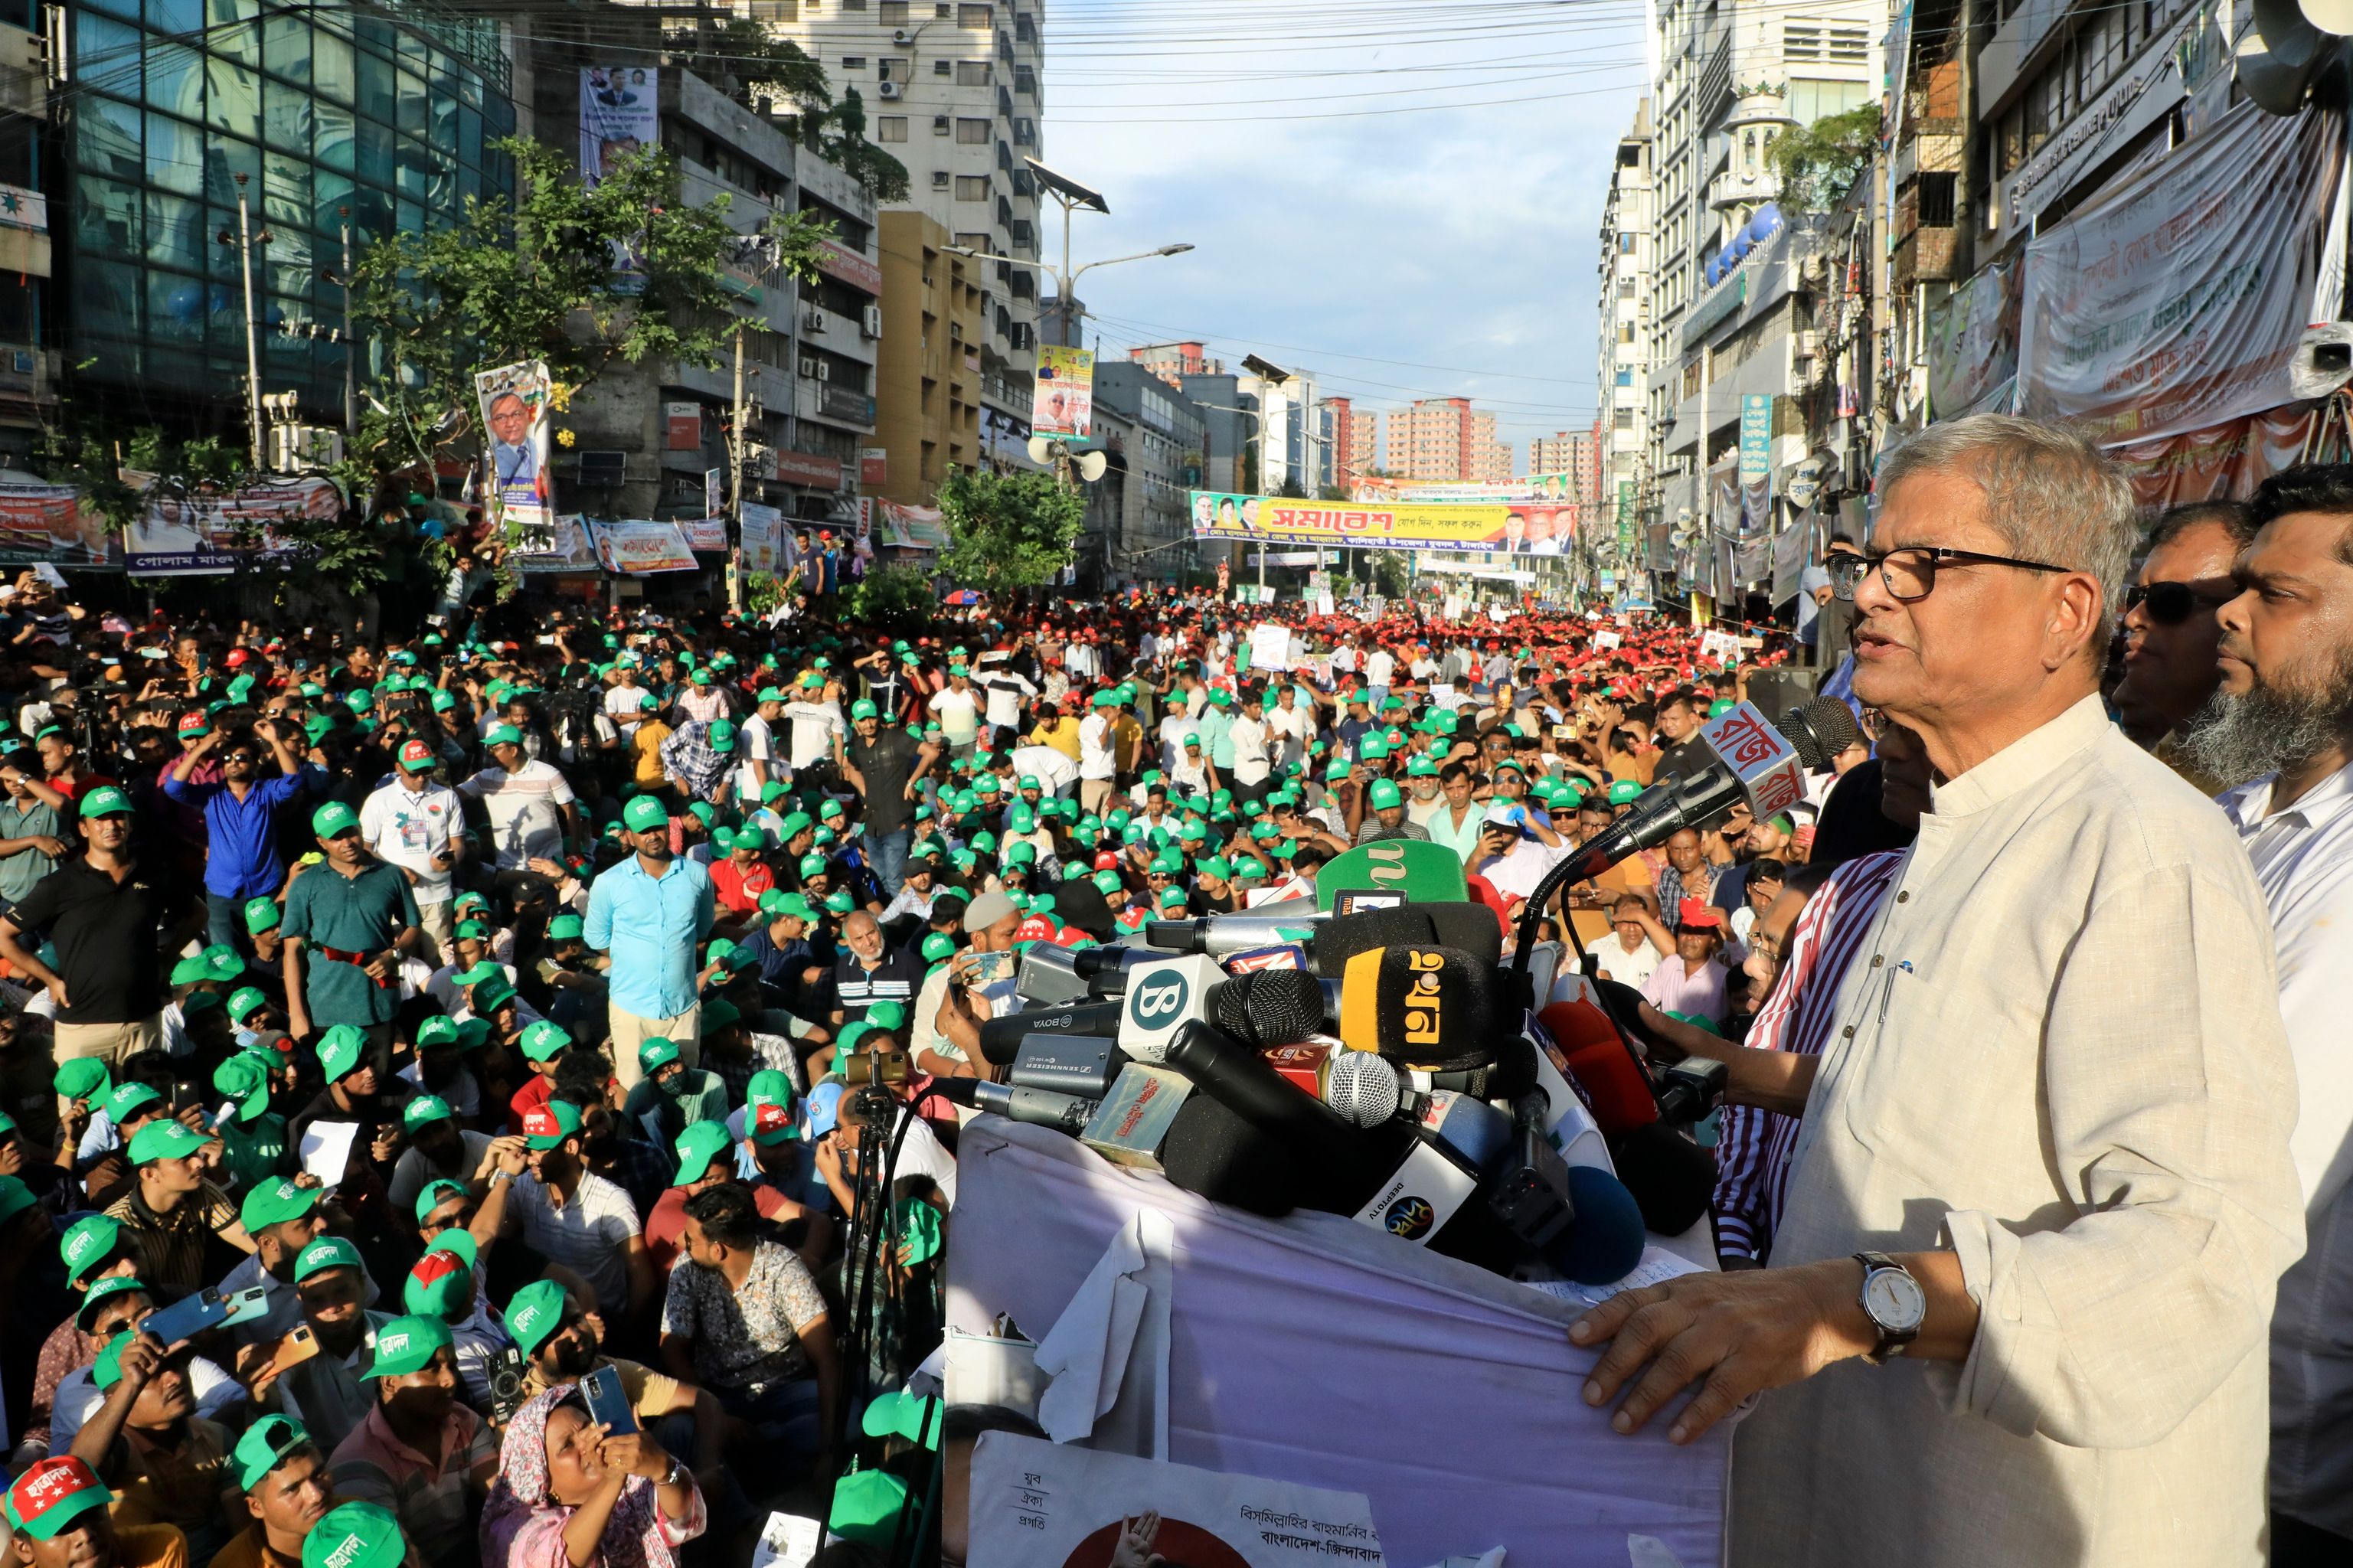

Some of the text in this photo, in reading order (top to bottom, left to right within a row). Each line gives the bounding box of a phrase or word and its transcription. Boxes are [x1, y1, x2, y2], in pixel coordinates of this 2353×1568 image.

[1791, 484, 1815, 498] রাজ
[858, 498, 869, 537] Bata
[1270, 508, 1394, 535] সমাবেশ
[1397, 516, 1416, 528] যোগ
[1417, 515, 1435, 530] দিন,
[1437, 519, 1459, 529] সফল
[1347, 536, 1387, 546] কালিহাতী
[1388, 538, 1427, 548] উপজেলা
[1428, 540, 1458, 550] যুবদল,
[136, 557, 193, 567] গোলাম
[1711, 708, 1782, 773] রাজ
[1755, 761, 1802, 820] রাজ
[1404, 949, 1446, 1045] এখন
[1033, 1017, 1060, 1028] BOYA
[1025, 1062, 1080, 1073] SENNHEISER
[1369, 1182, 1404, 1220] DEEPTO TV
[67, 1231, 94, 1262] ছাত্রদল
[306, 1246, 339, 1266] ছাত্রদল
[514, 1305, 541, 1333] ছাত্রদল
[380, 1333, 410, 1357] ছাত্রদল
[25, 1465, 74, 1499] ছাত্রদল
[1025, 1472, 1041, 1486] যুব
[1021, 1490, 1044, 1507] ঐক্য
[1018, 1515, 1046, 1530] প্রগতি
[1261, 1530, 1383, 1563] বাংলাদেশ-জিন্দাবাদ
